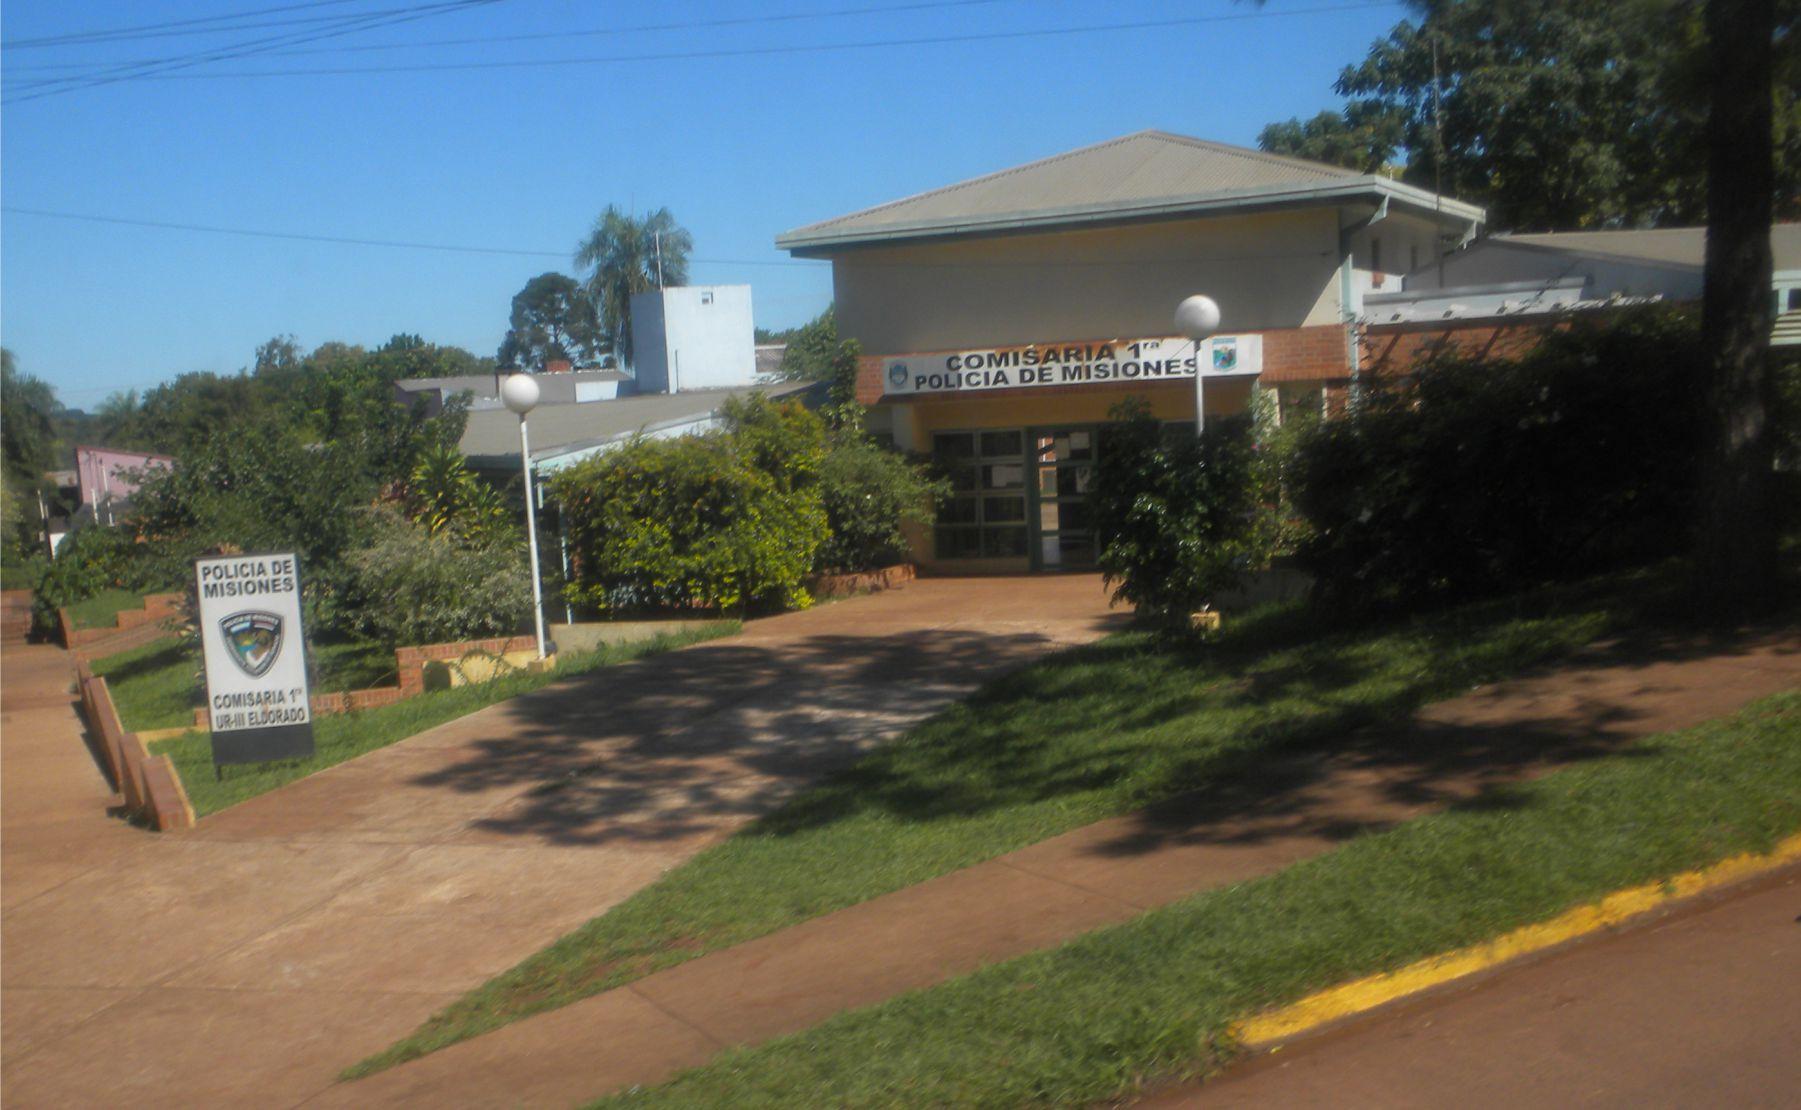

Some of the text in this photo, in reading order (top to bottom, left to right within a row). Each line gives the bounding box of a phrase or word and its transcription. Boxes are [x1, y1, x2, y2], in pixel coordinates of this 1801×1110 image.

[946, 340, 1160, 371] COMISARIA 1ra
[914, 358, 1198, 390] POLICIA DE MISIONES
[202, 559, 292, 581] POLICIA DE
[204, 577, 293, 598] MISIONES
[214, 690, 285, 709] COMISARIA
[216, 707, 305, 730] UR-III ELDORADO
